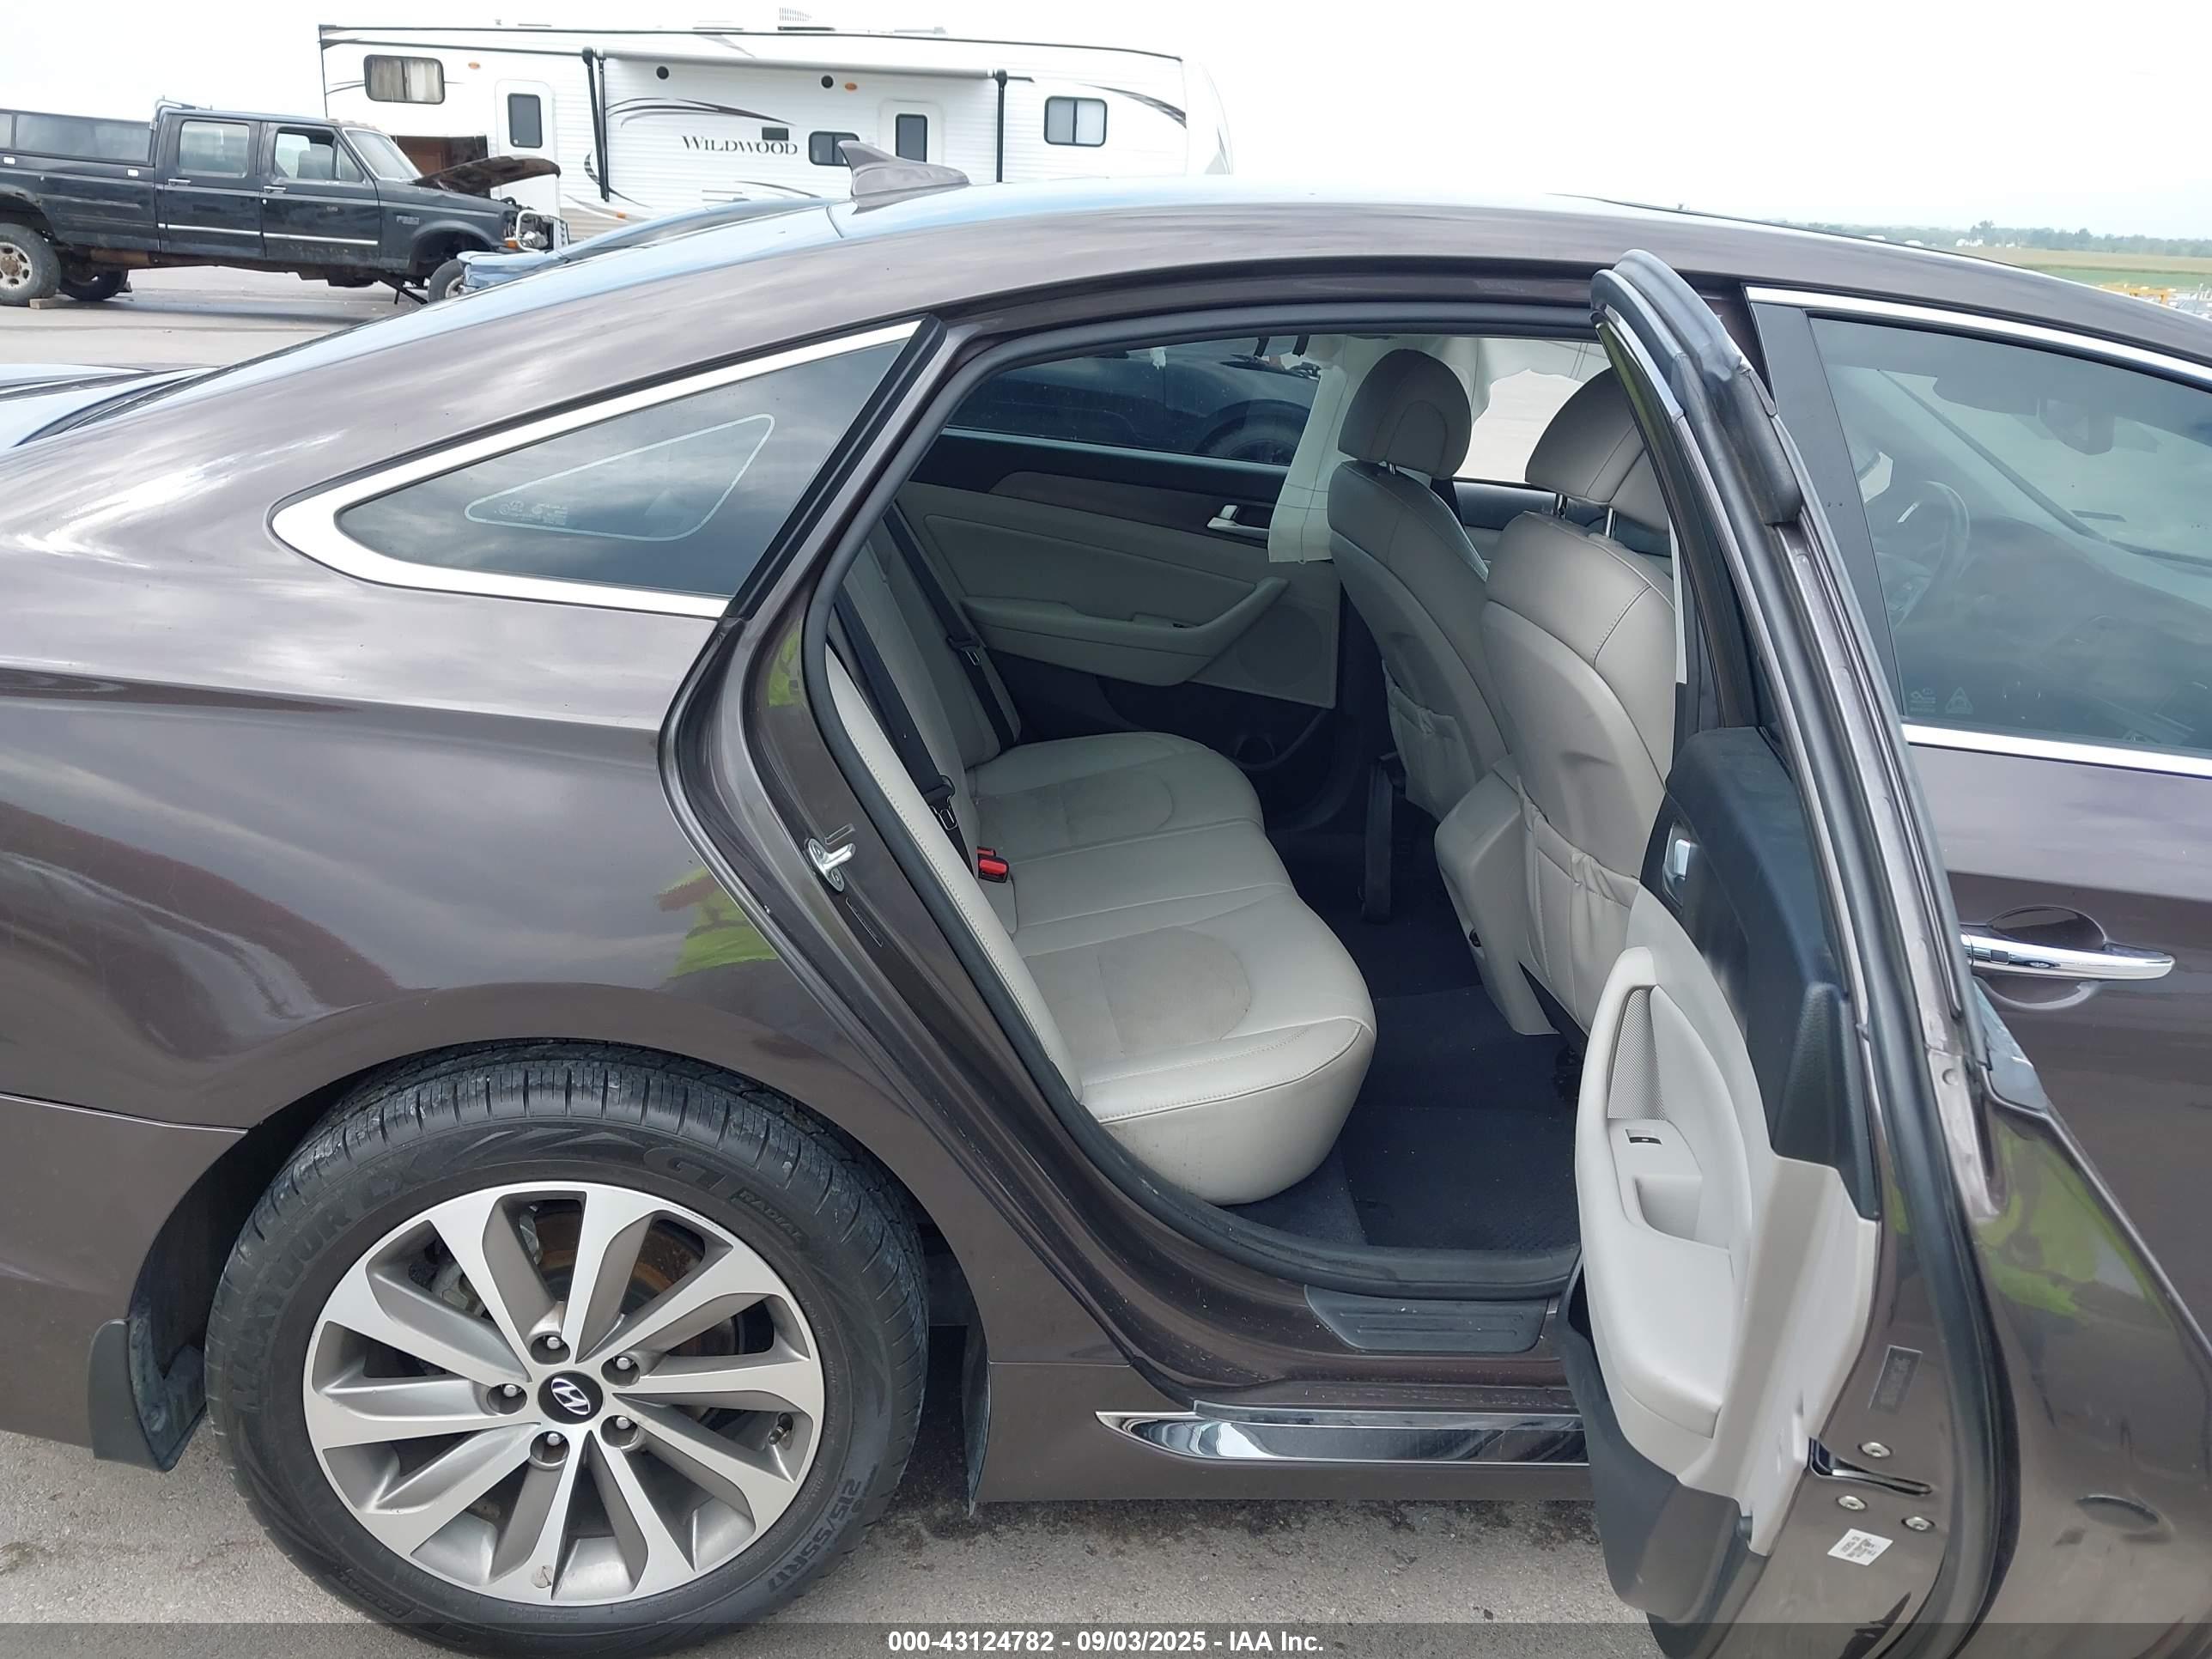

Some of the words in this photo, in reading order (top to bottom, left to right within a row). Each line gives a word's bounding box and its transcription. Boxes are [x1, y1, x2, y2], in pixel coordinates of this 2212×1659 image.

[682, 135, 798, 155] WILDWOOD
[738, 1188, 804, 1240] RADIAL
[768, 1478, 862, 1593] 215/55R17
